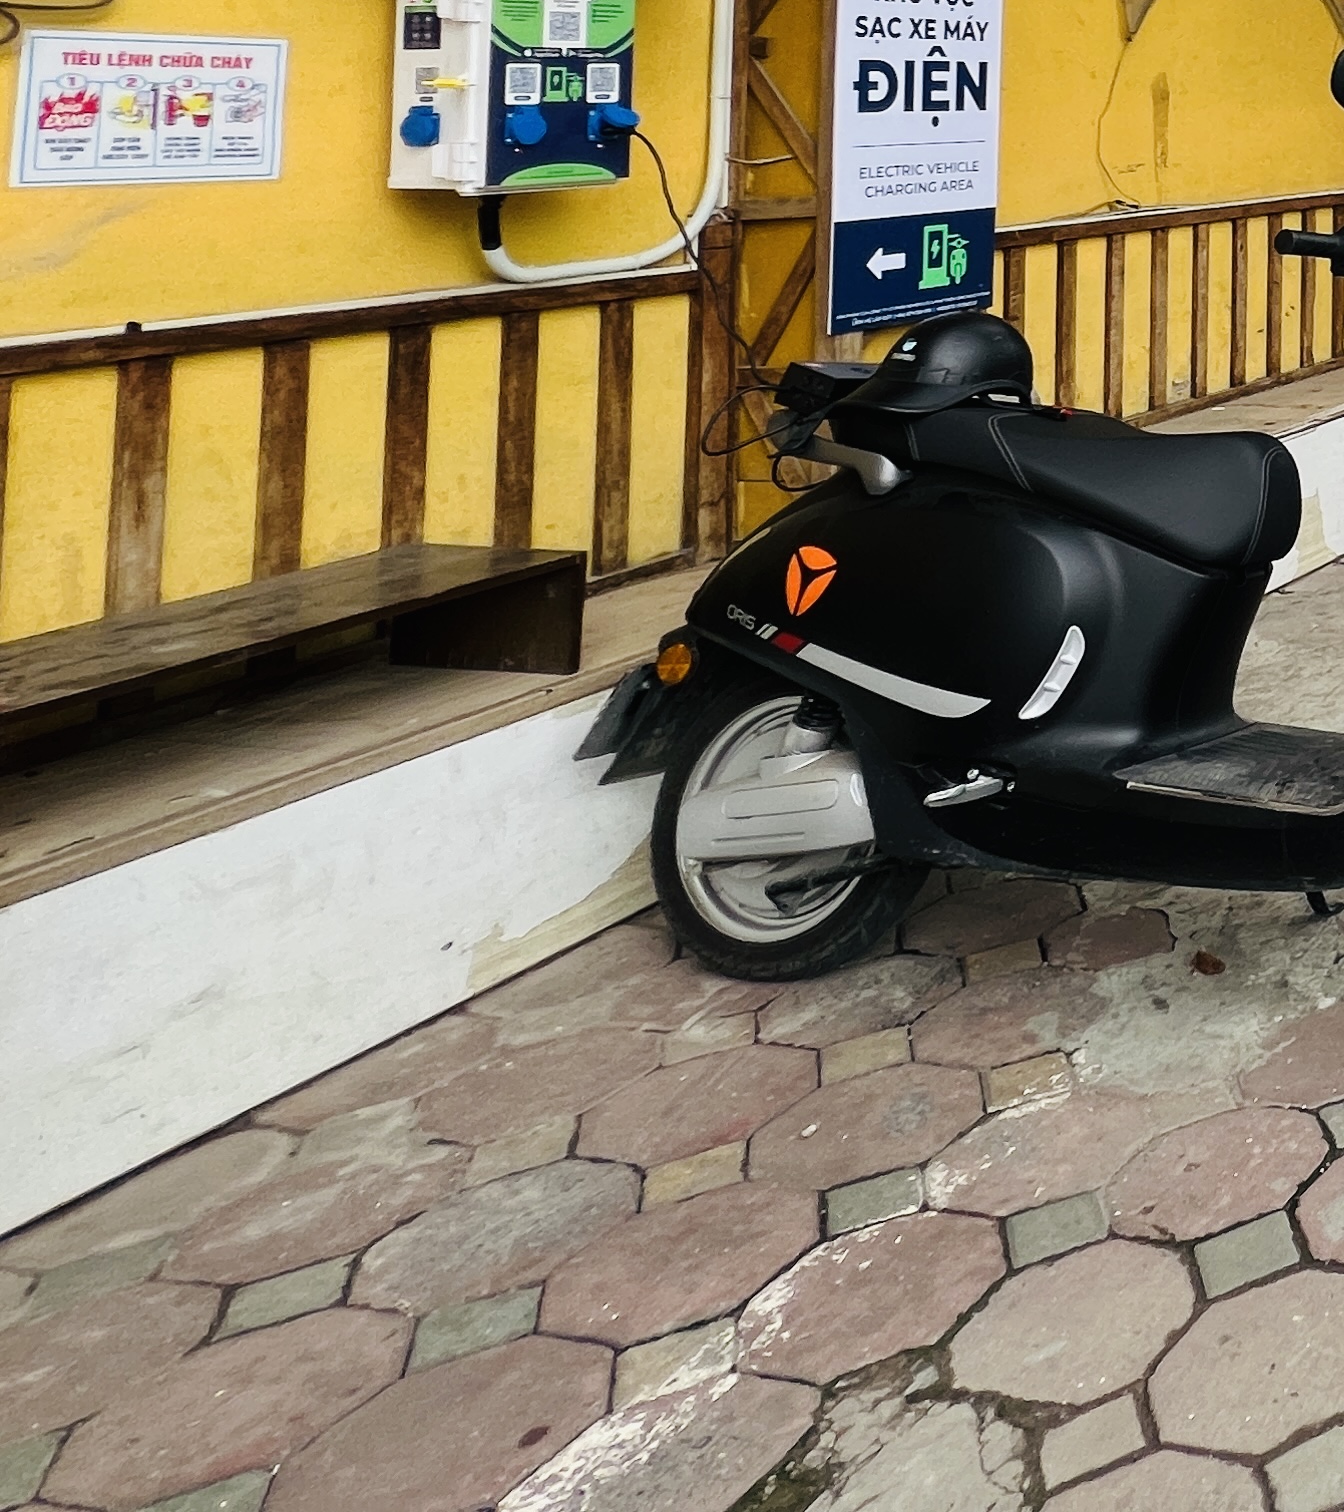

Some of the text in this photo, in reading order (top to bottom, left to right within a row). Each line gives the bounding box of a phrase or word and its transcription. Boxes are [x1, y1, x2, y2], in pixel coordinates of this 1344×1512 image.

[855, 15, 989, 44] SẠC XE MÁY
[62, 50, 254, 69] TIÊU LỆNH CHỮA CHÁY
[67, 76, 76, 87] 1
[126, 77, 138, 87] 2
[853, 45, 988, 128] ĐIỆN
[859, 160, 980, 180] ELECTRIC VEHICLE
[864, 179, 974, 198] CHARGING AREA
